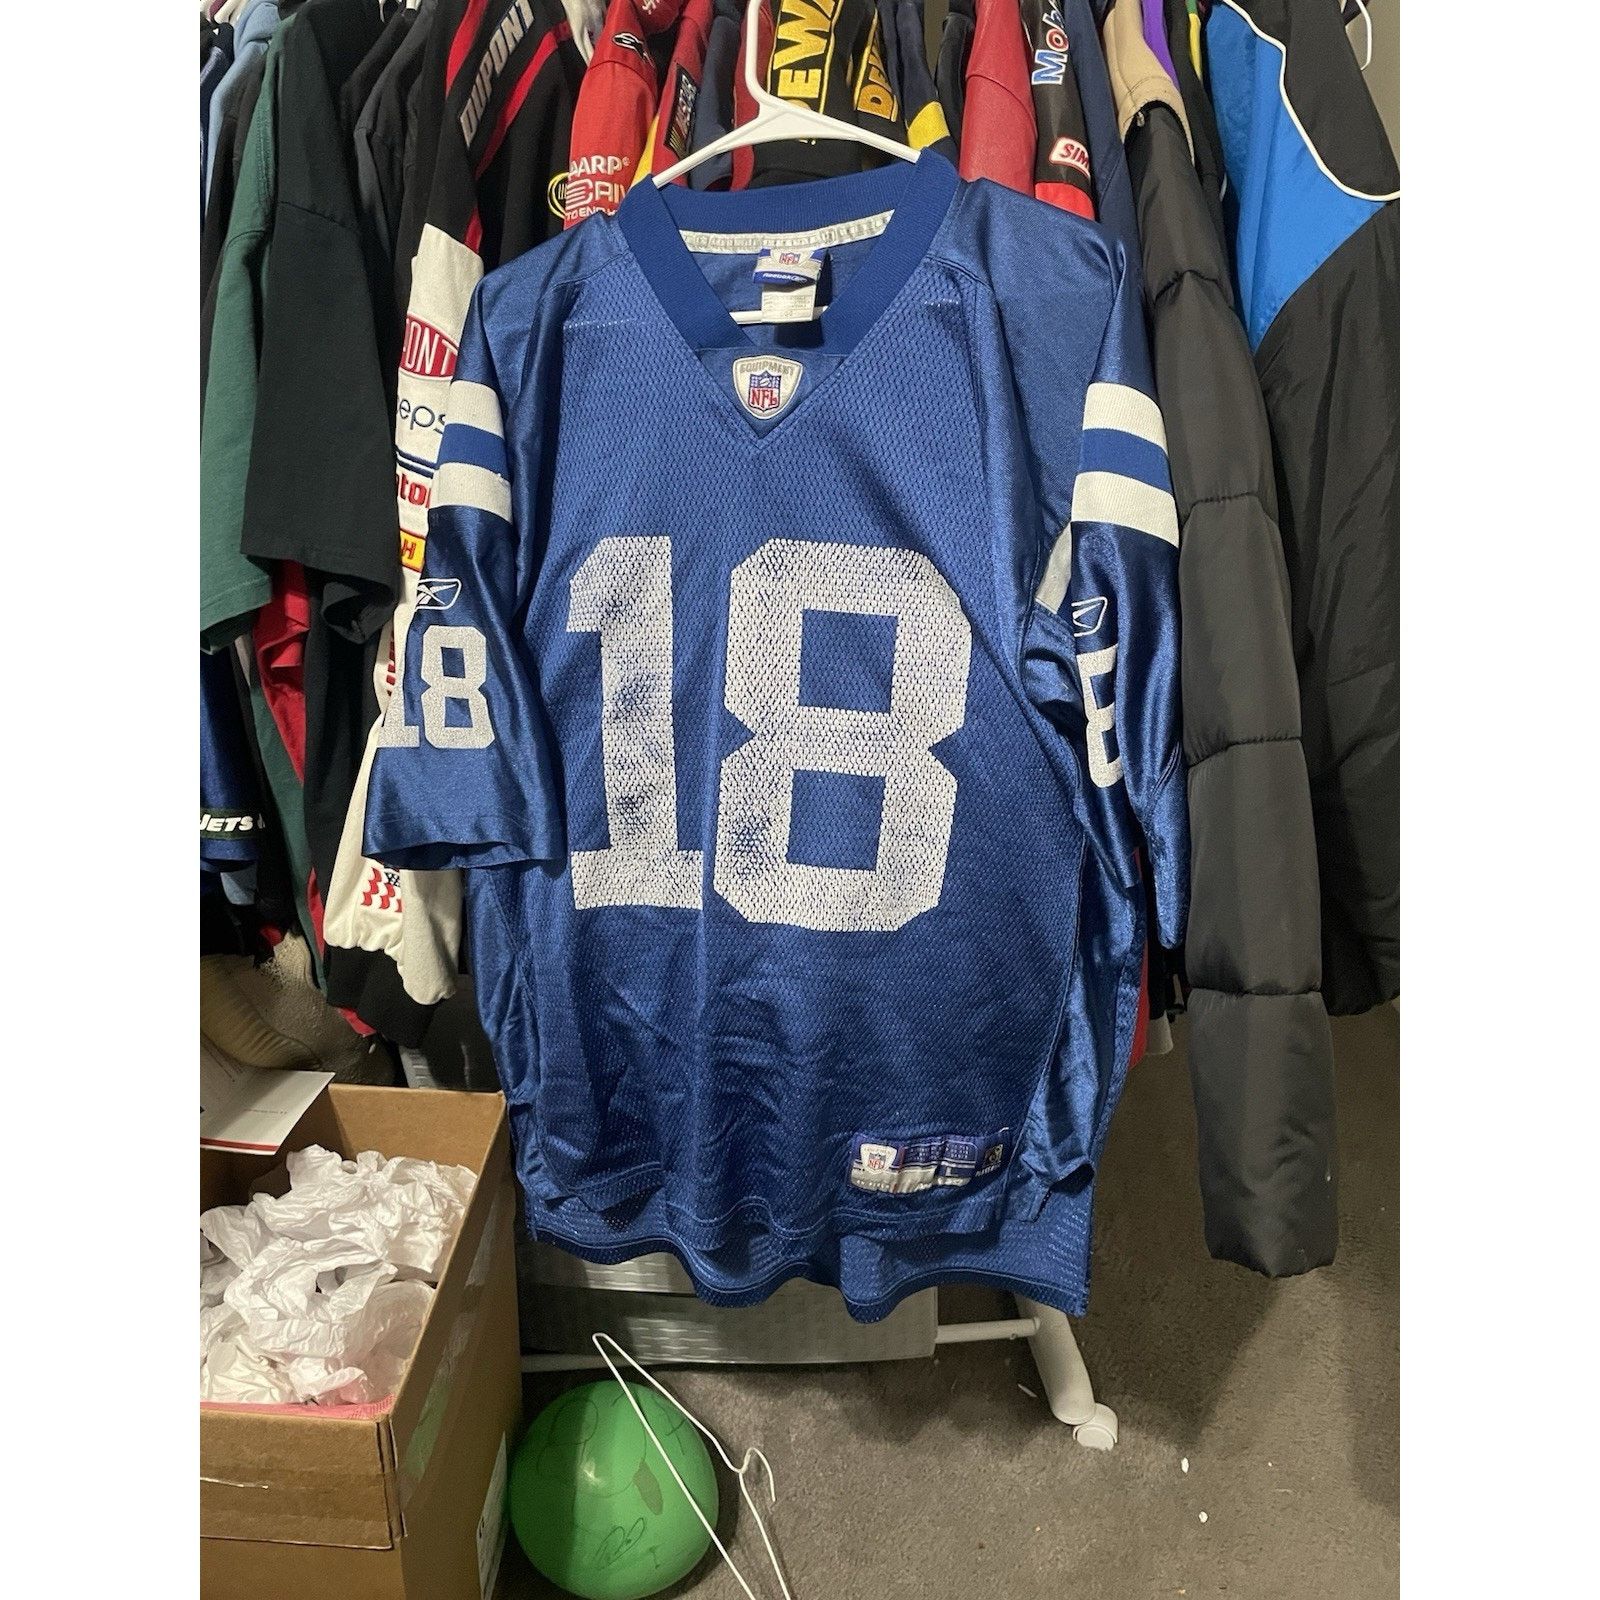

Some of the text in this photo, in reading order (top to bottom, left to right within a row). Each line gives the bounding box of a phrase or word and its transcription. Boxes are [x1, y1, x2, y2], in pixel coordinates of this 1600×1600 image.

[460, 0, 534, 148] DUPONT
[402, 318, 457, 375] ONT
[740, 361, 795, 376] EQUIPMENT
[751, 388, 778, 408] NFL
[377, 625, 495, 750] 18
[567, 535, 972, 932] 18
[199, 813, 253, 832] JETS
